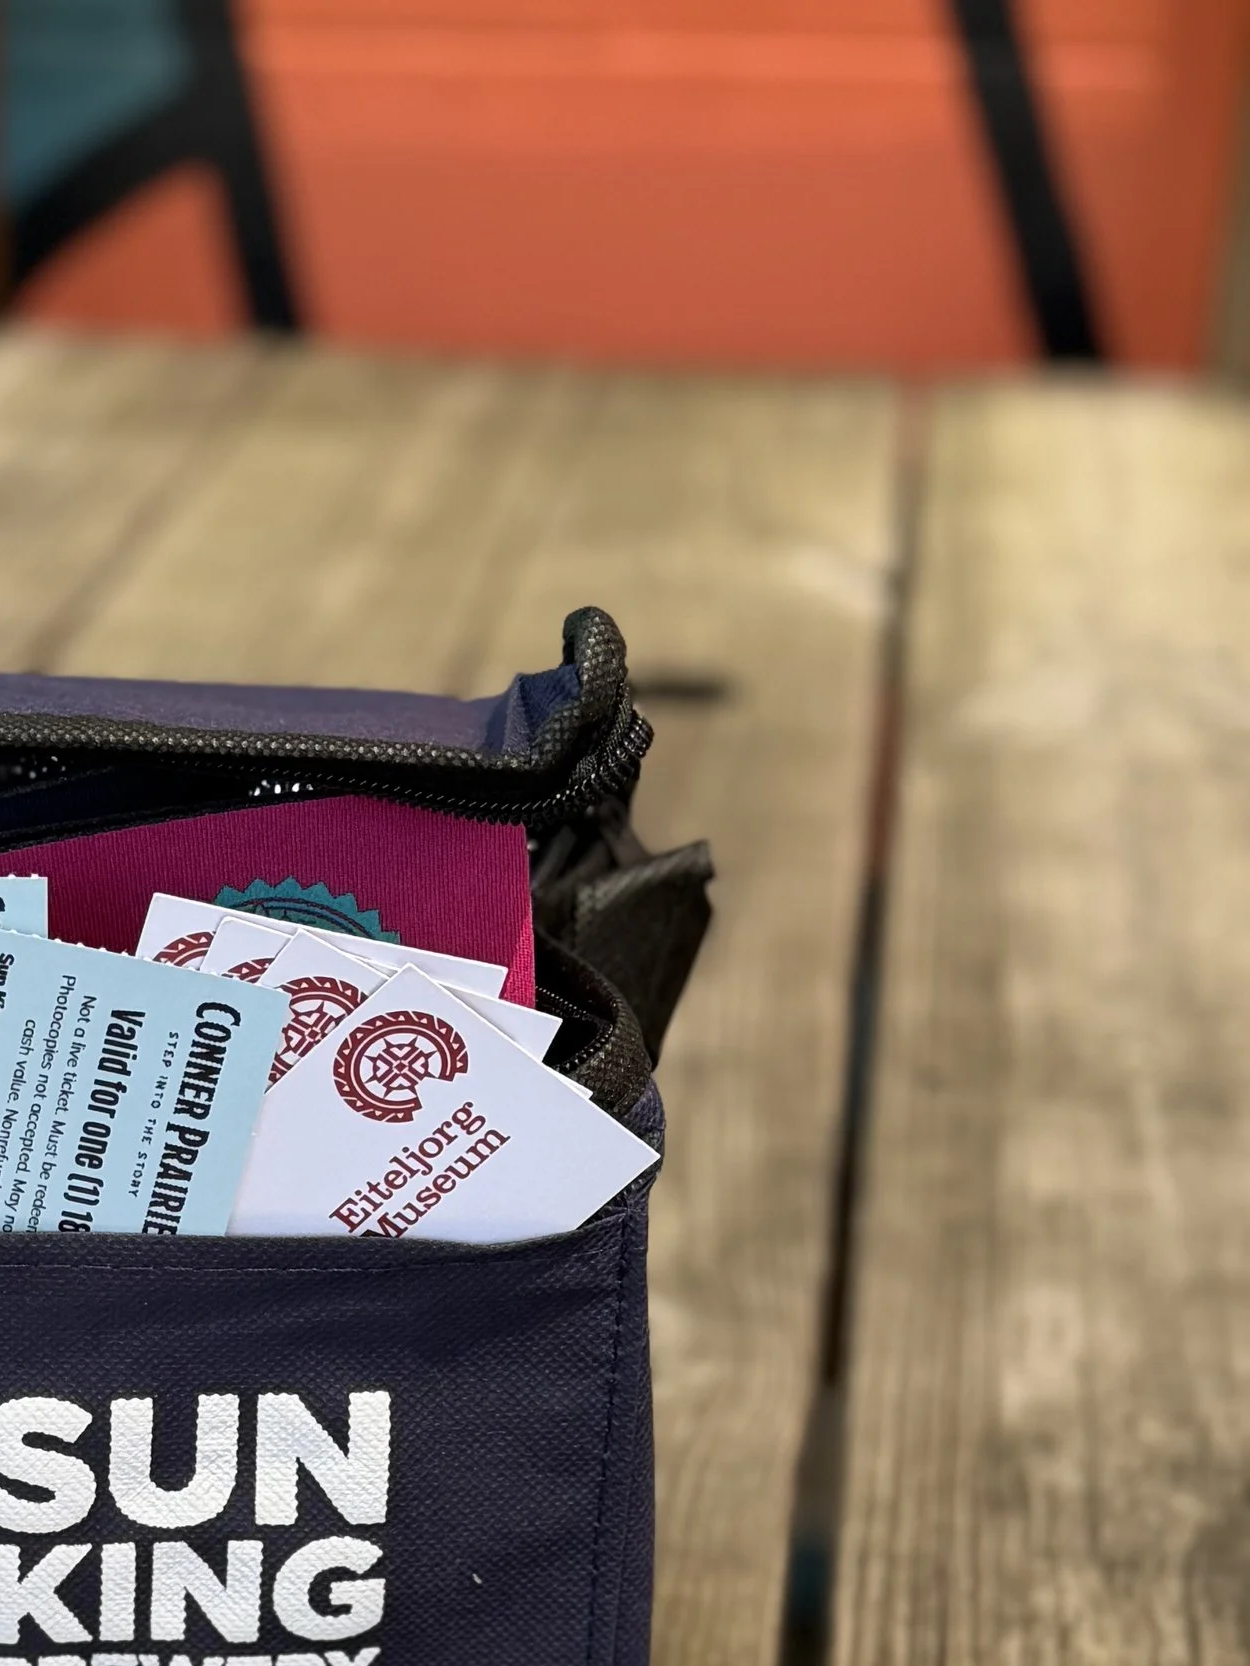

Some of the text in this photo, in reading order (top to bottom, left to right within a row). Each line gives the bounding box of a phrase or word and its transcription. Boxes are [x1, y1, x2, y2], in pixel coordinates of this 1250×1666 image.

[40, 974, 76, 1070] Photocopies
[77, 995, 97, 1024] Not
[19, 1019, 36, 1056] cash
[74, 1027, 86, 1038] a
[97, 1009, 146, 1077] Valid
[66, 1041, 86, 1068] live
[7, 1060, 27, 1104] value.
[33, 1074, 49, 1100] not
[55, 1071, 77, 1115] ticket.
[87, 1079, 128, 1120] for
[128, 1031, 179, 1198] STEP INTO THE STORY
[141, 1001, 241, 1235] CONNER PRAIRIE
[15, 1103, 42, 1174] accepted.
[44, 1120, 66, 1158] Must
[74, 1121, 112, 1170] one
[39, 1161, 57, 1180] be
[328, 1101, 486, 1234] Eiteljorg
[4, 1178, 27, 1212] May
[63, 1172, 104, 1206] (1)
